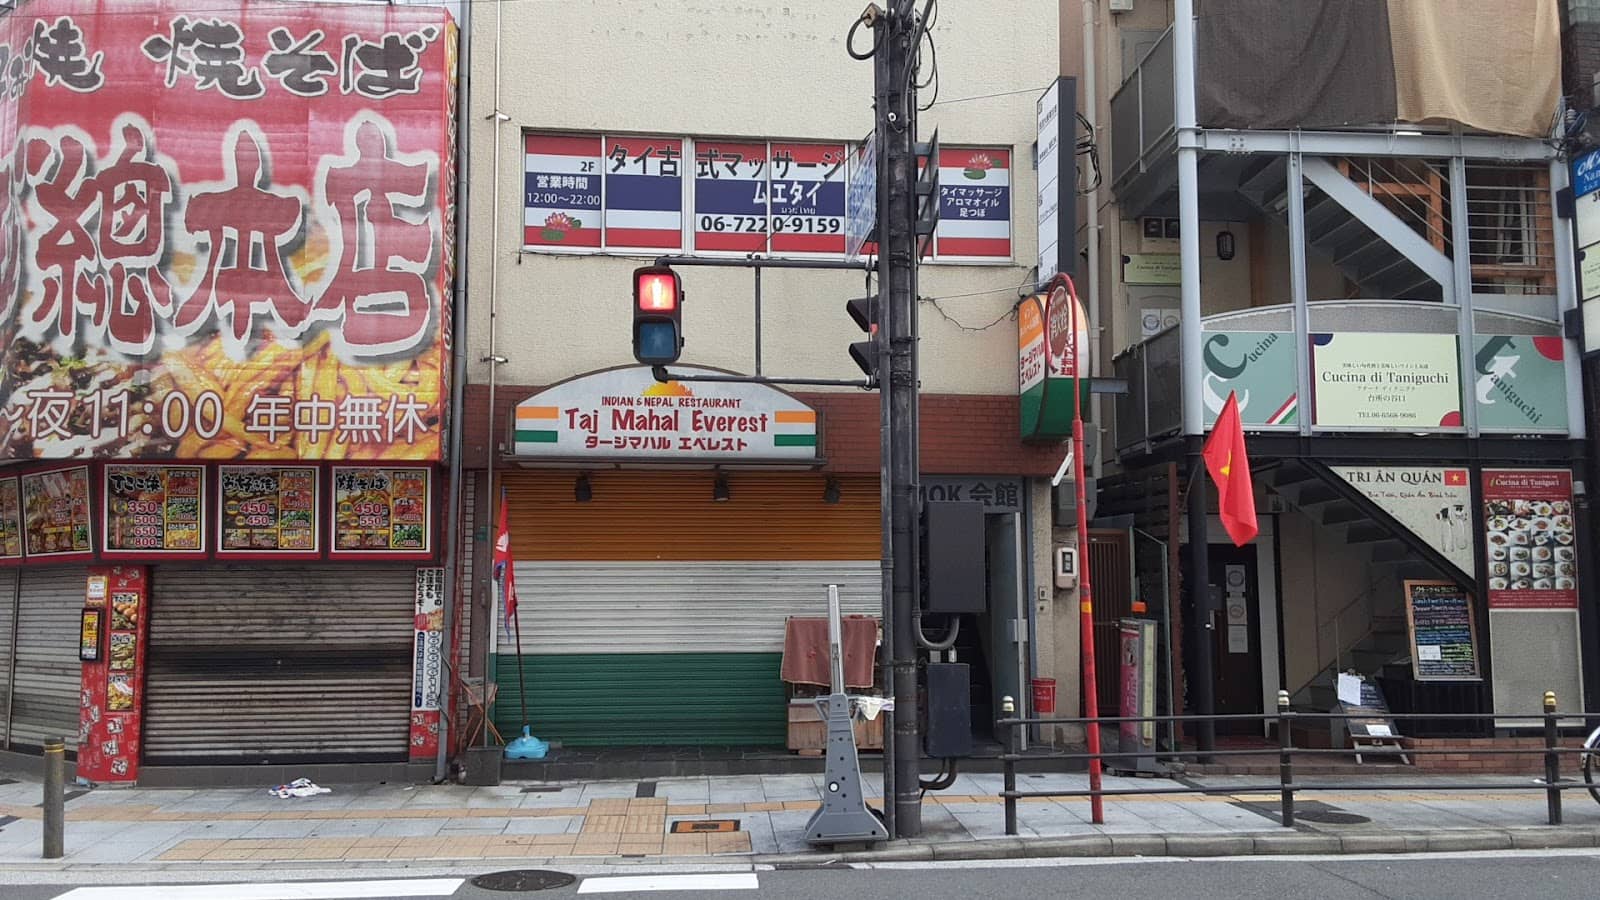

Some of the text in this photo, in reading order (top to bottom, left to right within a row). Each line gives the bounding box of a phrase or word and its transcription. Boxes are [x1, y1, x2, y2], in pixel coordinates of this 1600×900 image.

[141, 15, 440, 99] 焼そば
[580, 161, 594, 172] 2F
[536, 174, 588, 189] 営業時間
[753, 181, 821, 206] ムエタイ
[941, 187, 1002, 197] タイマッサージ
[946, 198, 1000, 207] アロマオイル
[701, 215, 840, 233] 06-7220-9159
[1322, 371, 1449, 385] Cucina di Taniguchi
[602, 396, 634, 407] INDIAN
[643, 397, 673, 408] NEPAL
[678, 398, 742, 409] RESTAURANT
[247, 393, 429, 443] 年中無休
[565, 408, 768, 433] Taj Mahal Everest
[585, 436, 748, 451] タージマハル エベレスト
[969, 482, 1018, 507] 会館
